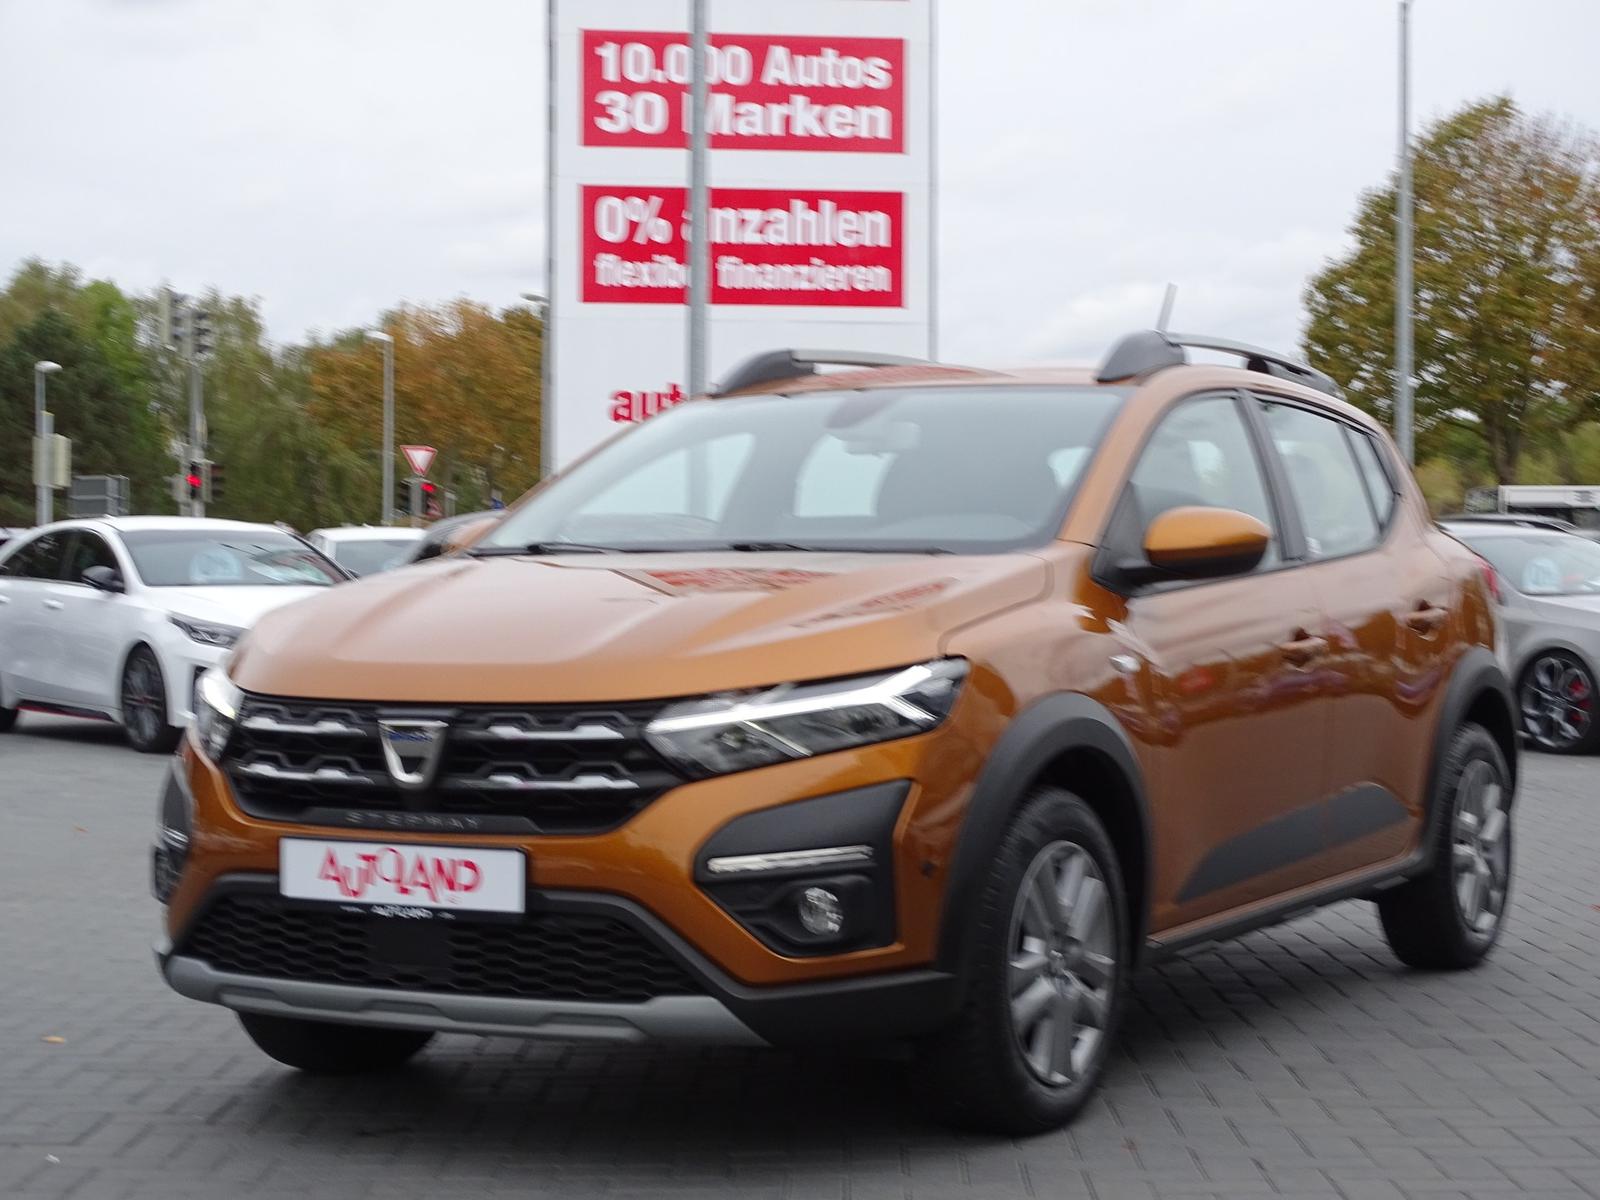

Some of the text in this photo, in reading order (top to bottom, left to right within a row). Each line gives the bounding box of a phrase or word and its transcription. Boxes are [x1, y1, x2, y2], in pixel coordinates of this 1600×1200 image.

[594, 41, 893, 90] 10.000 Autos
[594, 90, 893, 140] 30 Marken
[594, 195, 673, 245] 0%
[593, 252, 893, 292] flexib finanzieren
[608, 381, 688, 424] aut
